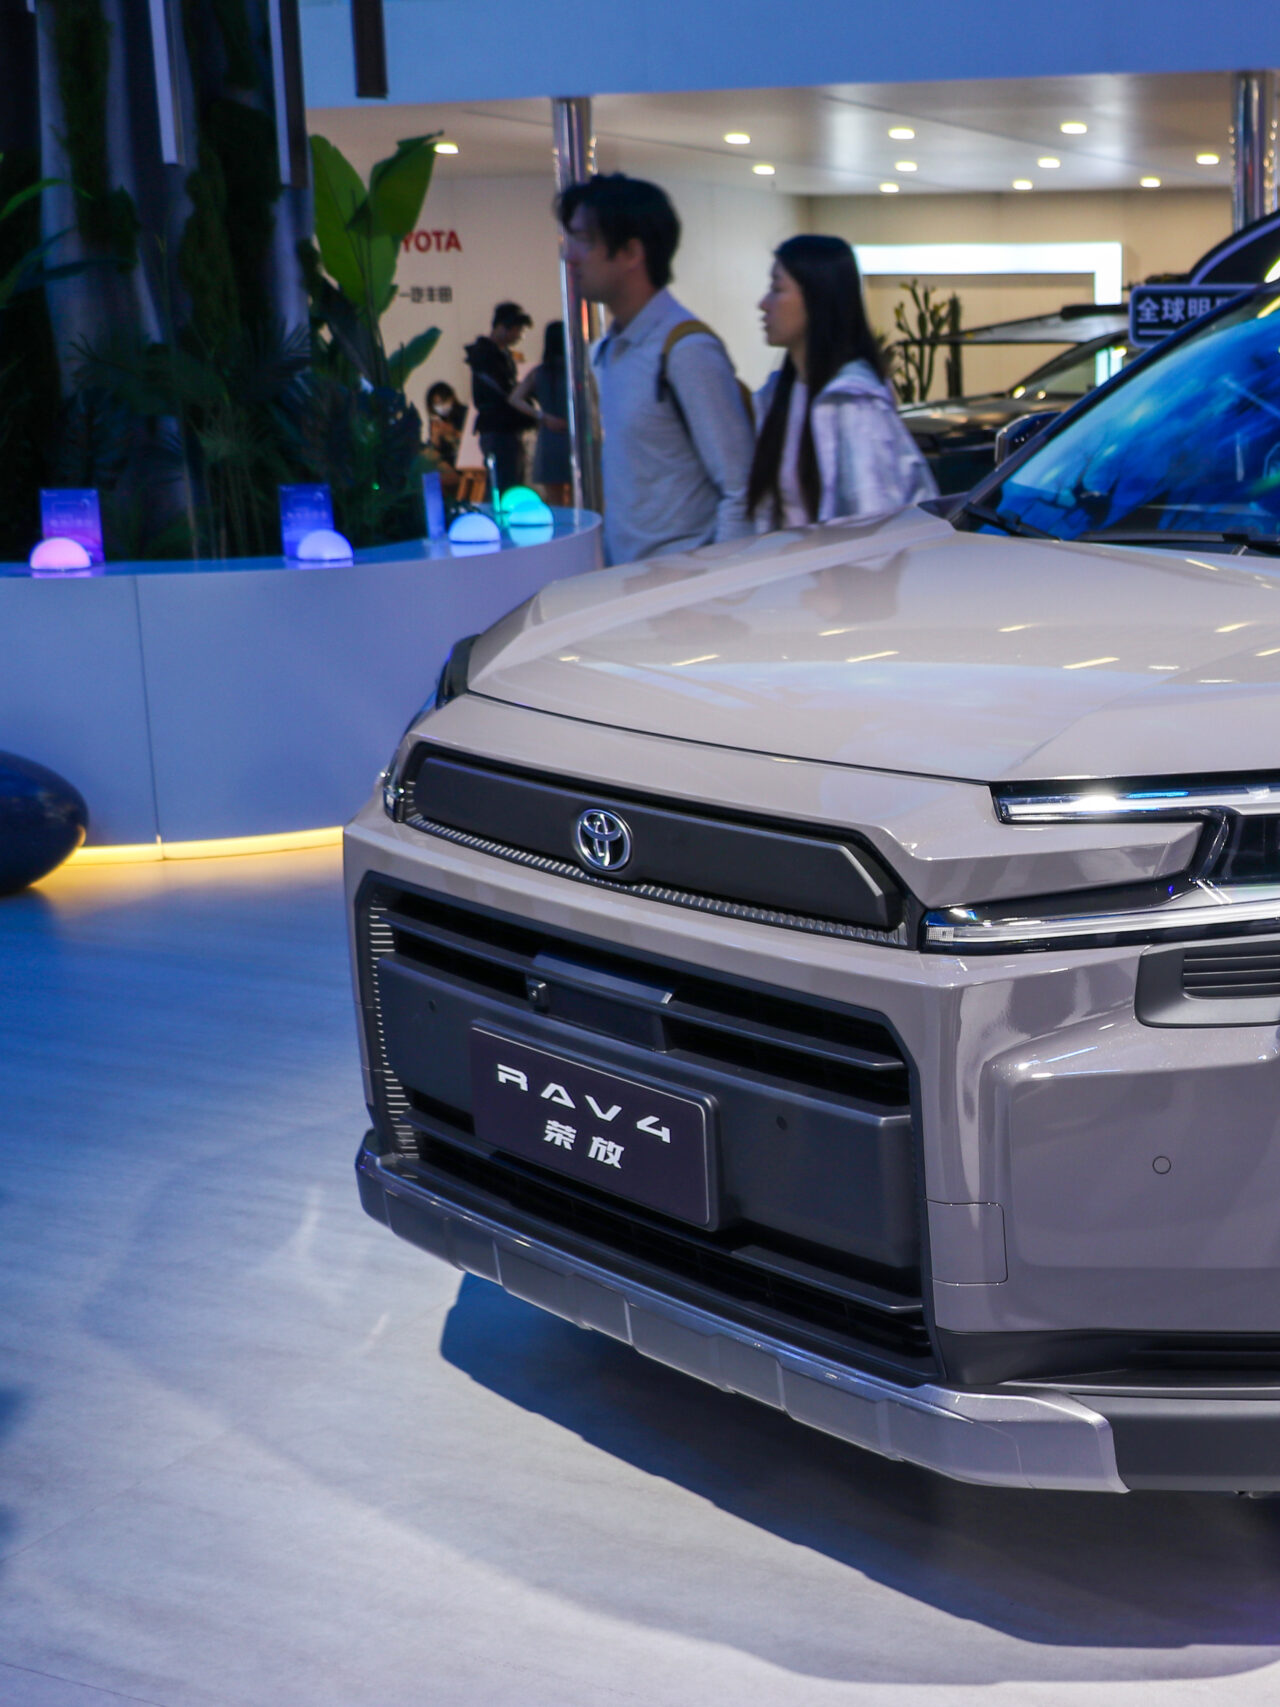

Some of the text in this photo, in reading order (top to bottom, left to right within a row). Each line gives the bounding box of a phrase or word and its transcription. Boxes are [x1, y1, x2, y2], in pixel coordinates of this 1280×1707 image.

[401, 230, 462, 252] YOTA
[497, 1063, 672, 1144] RAV4
[543, 1119, 625, 1169] 荣放
